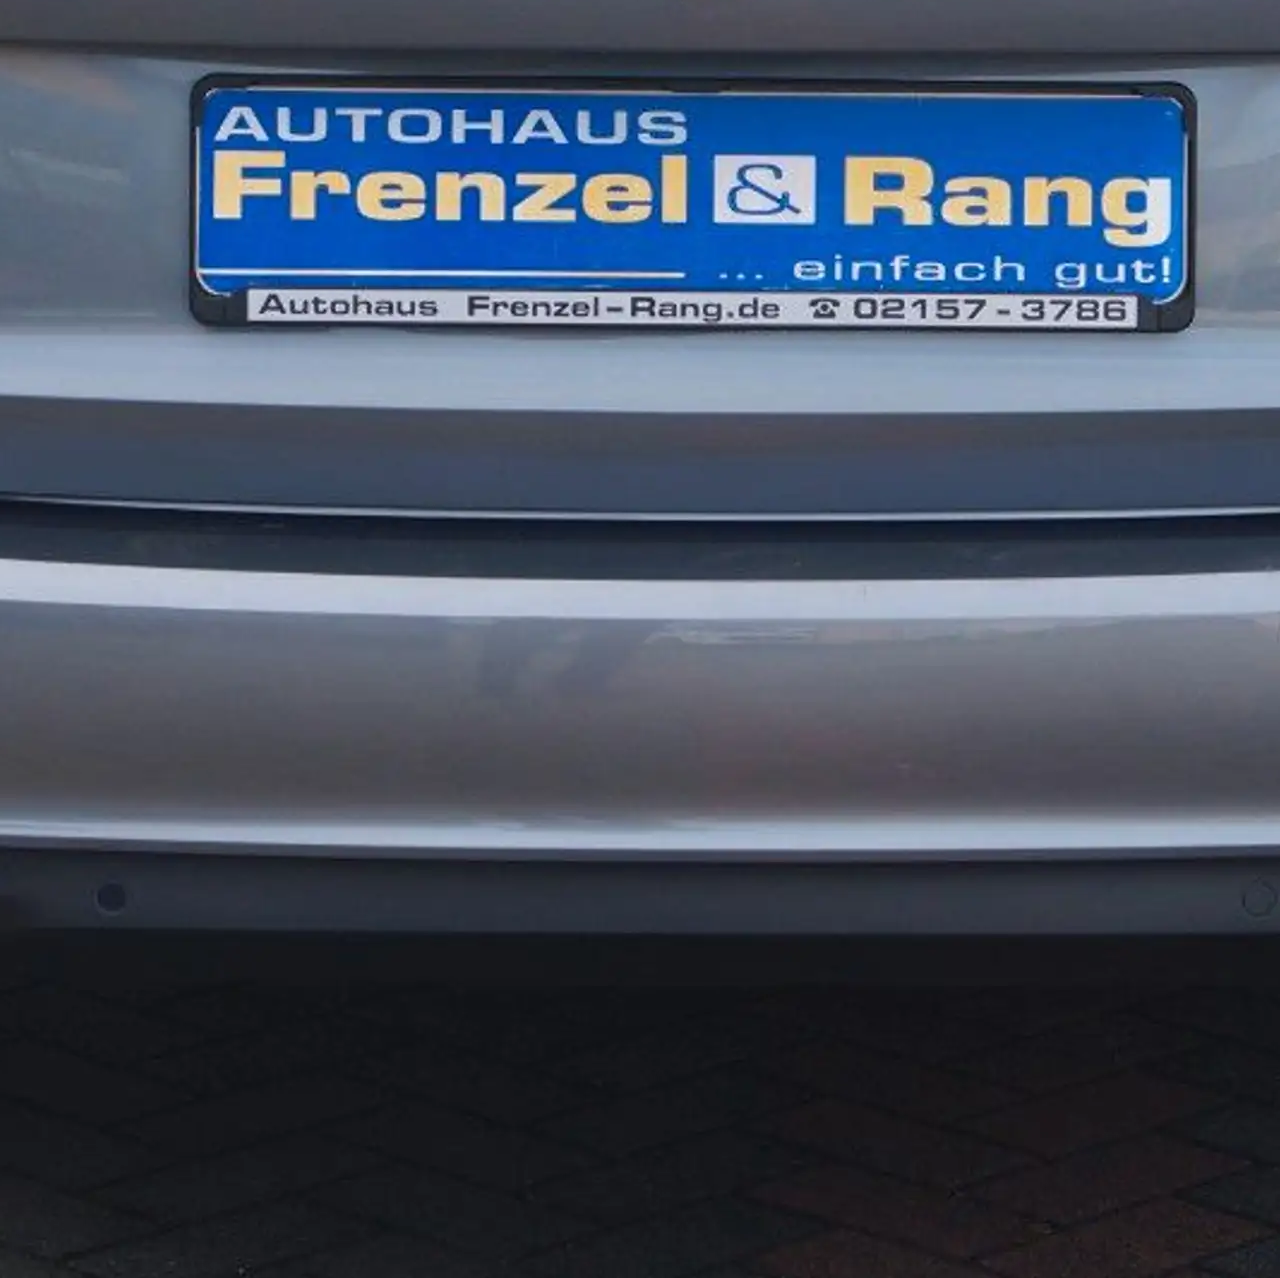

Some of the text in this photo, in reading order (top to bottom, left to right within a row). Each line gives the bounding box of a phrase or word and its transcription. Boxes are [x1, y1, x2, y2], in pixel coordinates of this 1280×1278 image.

[214, 107, 688, 146] AUTOHAUS
[212, 150, 1173, 248] Frenzel & Rang
[793, 255, 1025, 283] einfach
[1054, 255, 1173, 289] gut!
[259, 293, 439, 318] Autohaus
